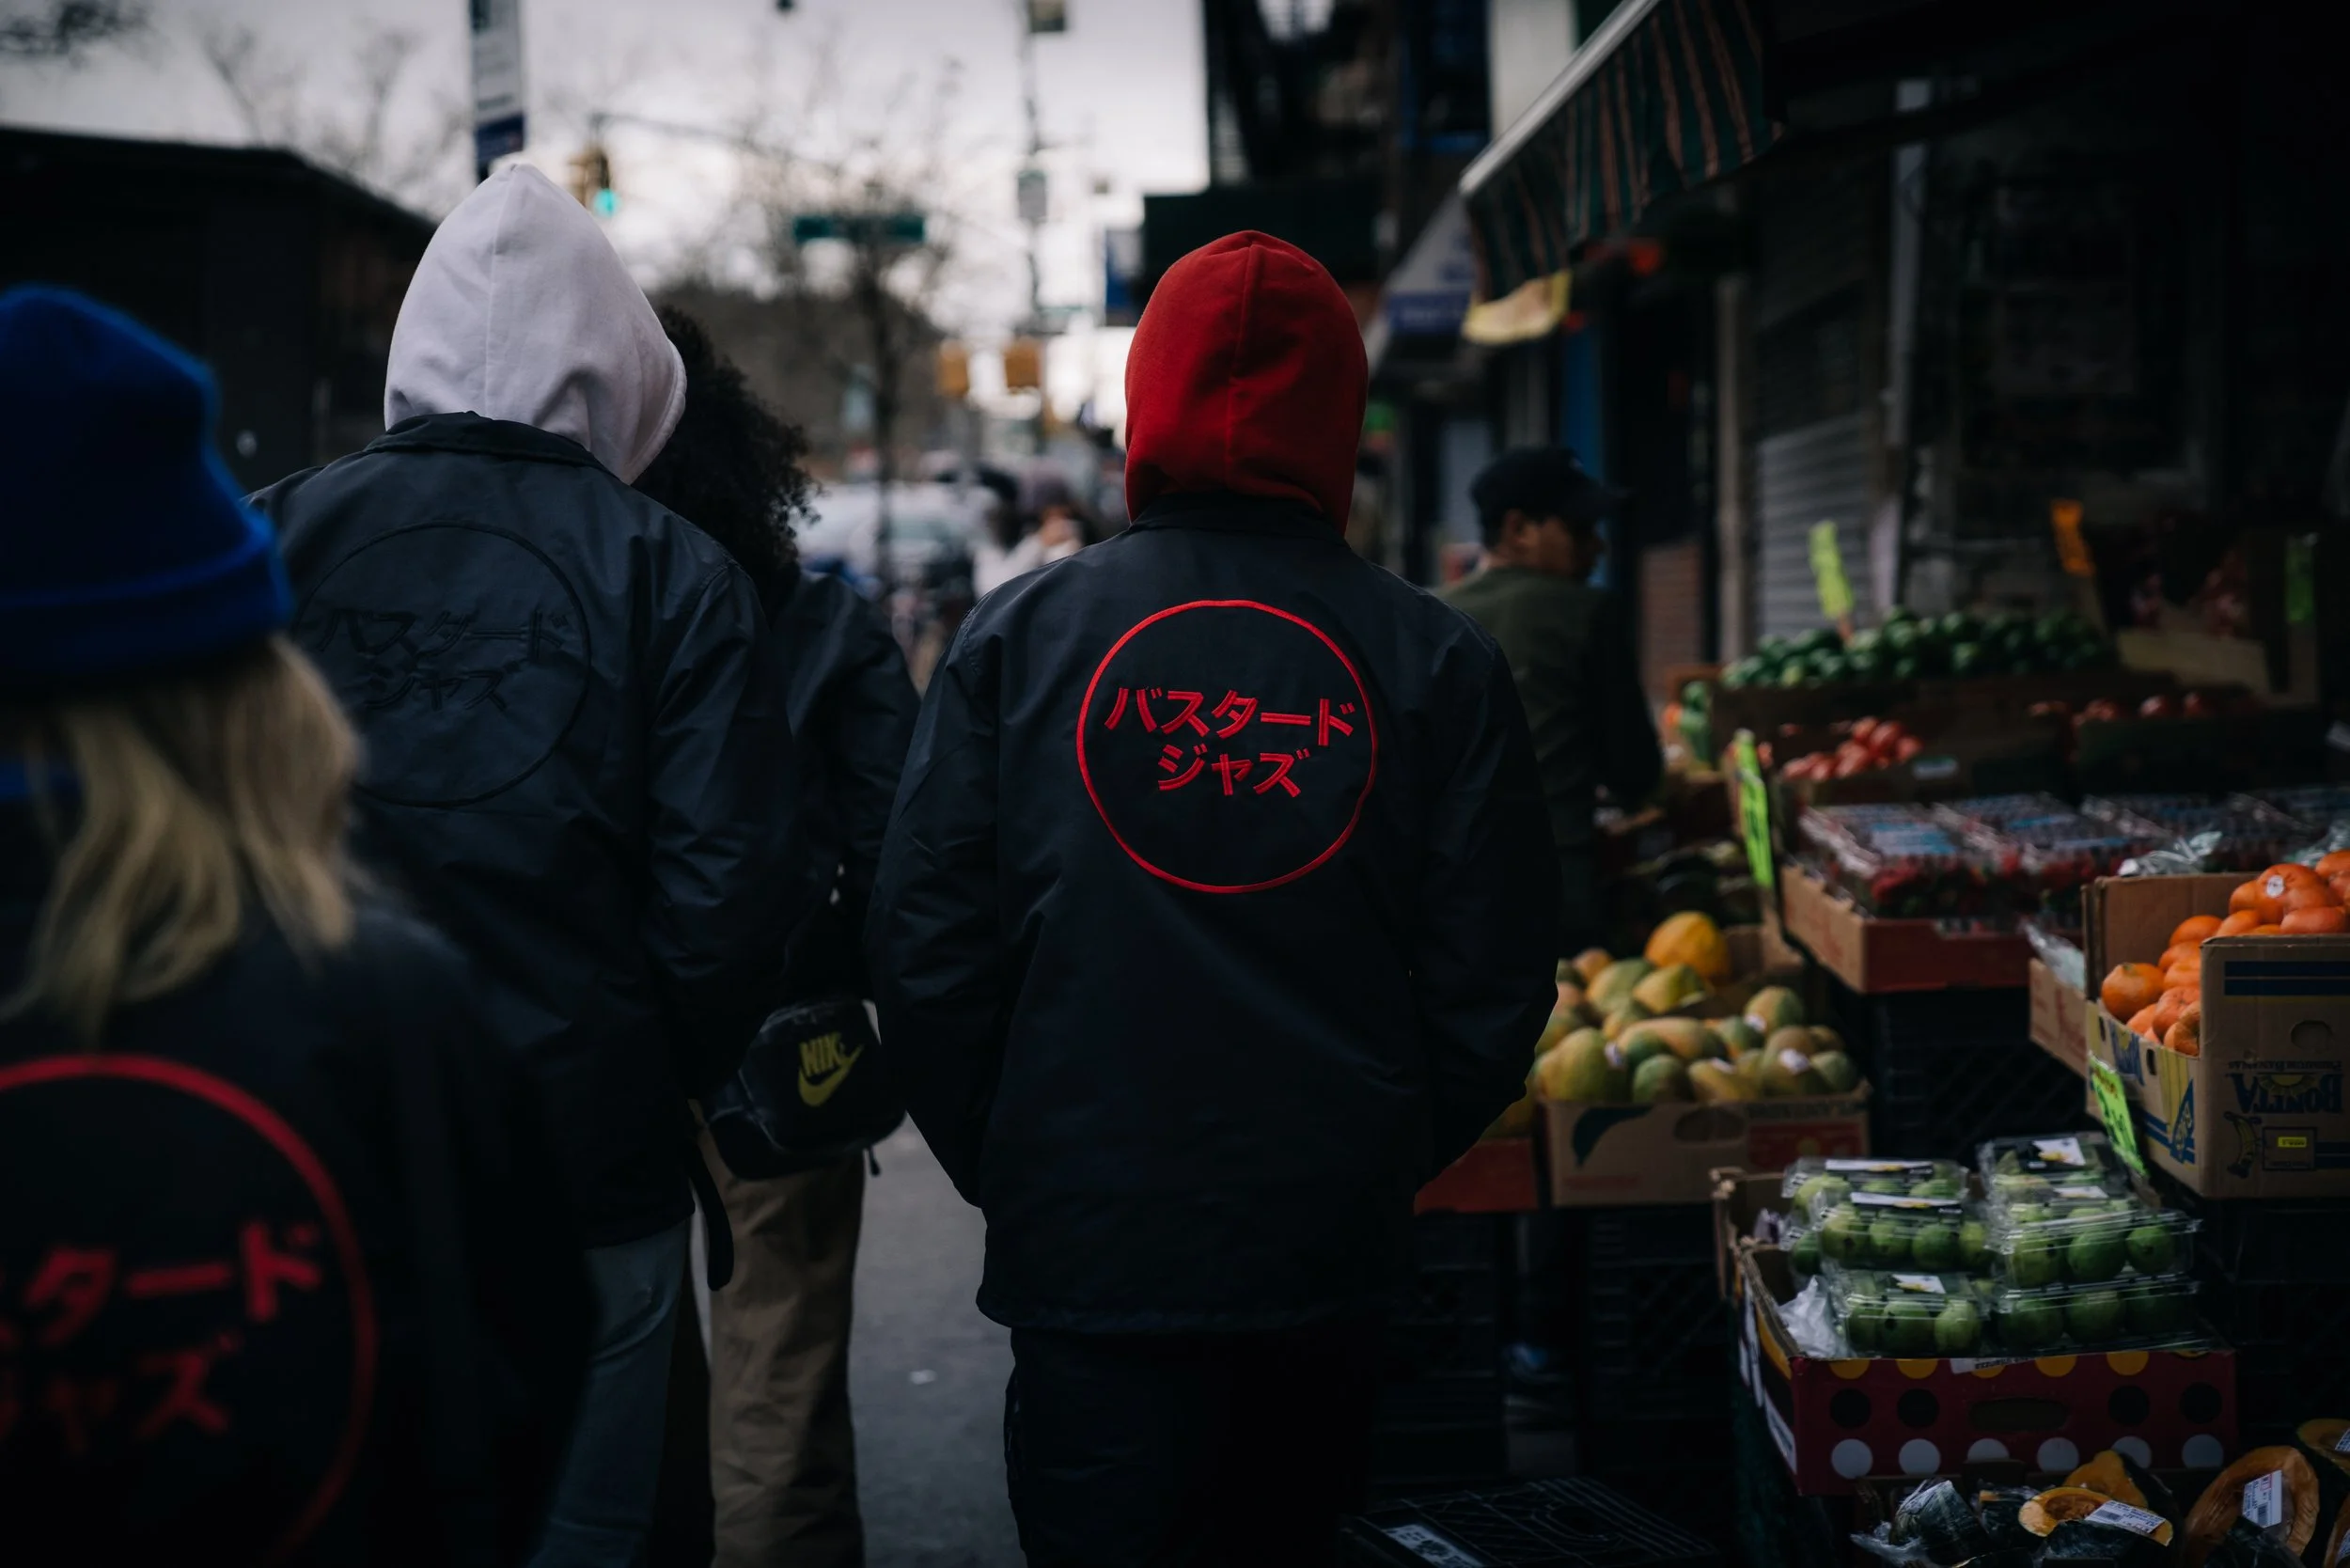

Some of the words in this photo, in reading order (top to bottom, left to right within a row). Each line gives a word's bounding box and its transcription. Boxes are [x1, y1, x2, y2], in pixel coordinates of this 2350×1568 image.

[1104, 687, 1355, 746] バスタード
[1157, 744, 1310, 797] ジャズ
[2225, 1074, 2342, 1114] BONITA
[0, 1221, 321, 1354] タード
[0, 1325, 244, 1457] ャズ
